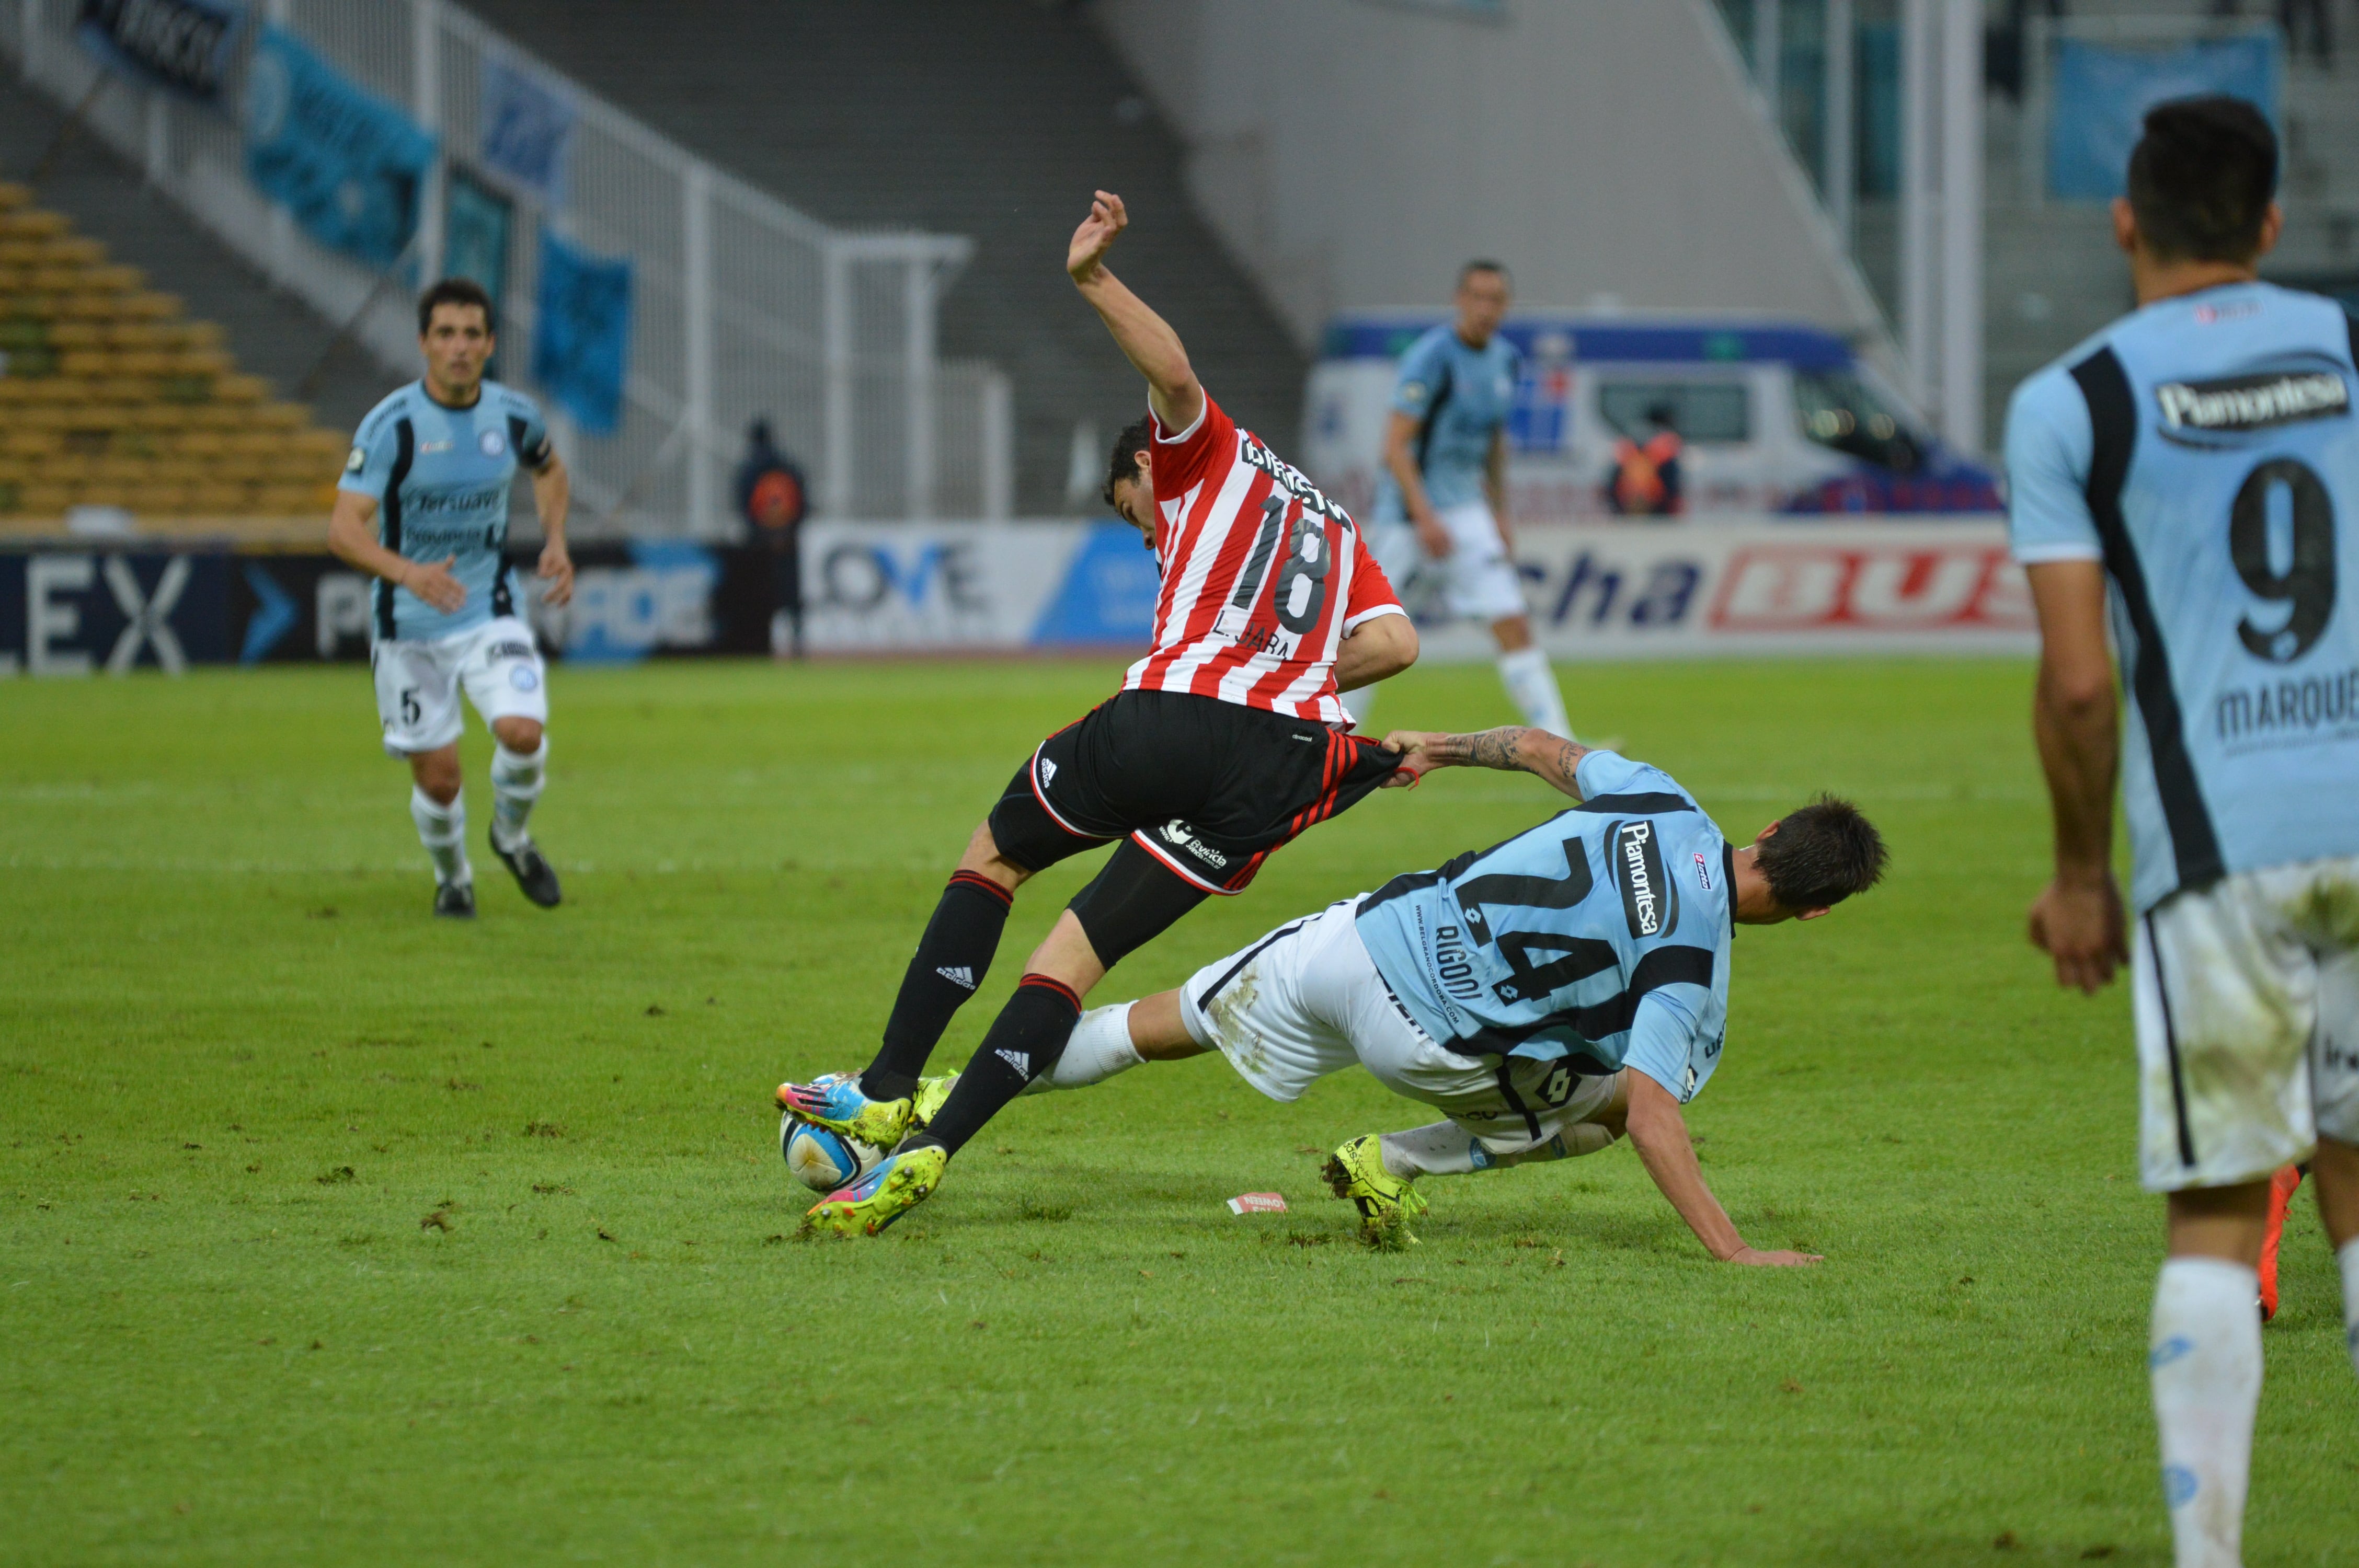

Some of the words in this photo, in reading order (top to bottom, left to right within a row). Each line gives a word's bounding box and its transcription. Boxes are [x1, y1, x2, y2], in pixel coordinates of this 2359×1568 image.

[804, 541, 993, 617] OVE
[1231, 494, 1332, 635] 18
[2229, 458, 2337, 663] 9
[0, 557, 191, 676] EX
[1213, 610, 1229, 637] L.
[1235, 622, 1288, 660] JARA
[401, 688, 421, 725] 5
[1041, 758, 1050, 789] adidas
[1622, 821, 1658, 935] Piamontesa
[1697, 862, 1709, 889] lotto
[1455, 836, 1620, 1007] 24
[936, 967, 976, 990] adidas
[1415, 905, 1459, 1024] WWW.BELGRANOCORDOBA.COM
[1437, 926, 1483, 1000] RIGONI
[994, 1048, 1029, 1081] adidas
